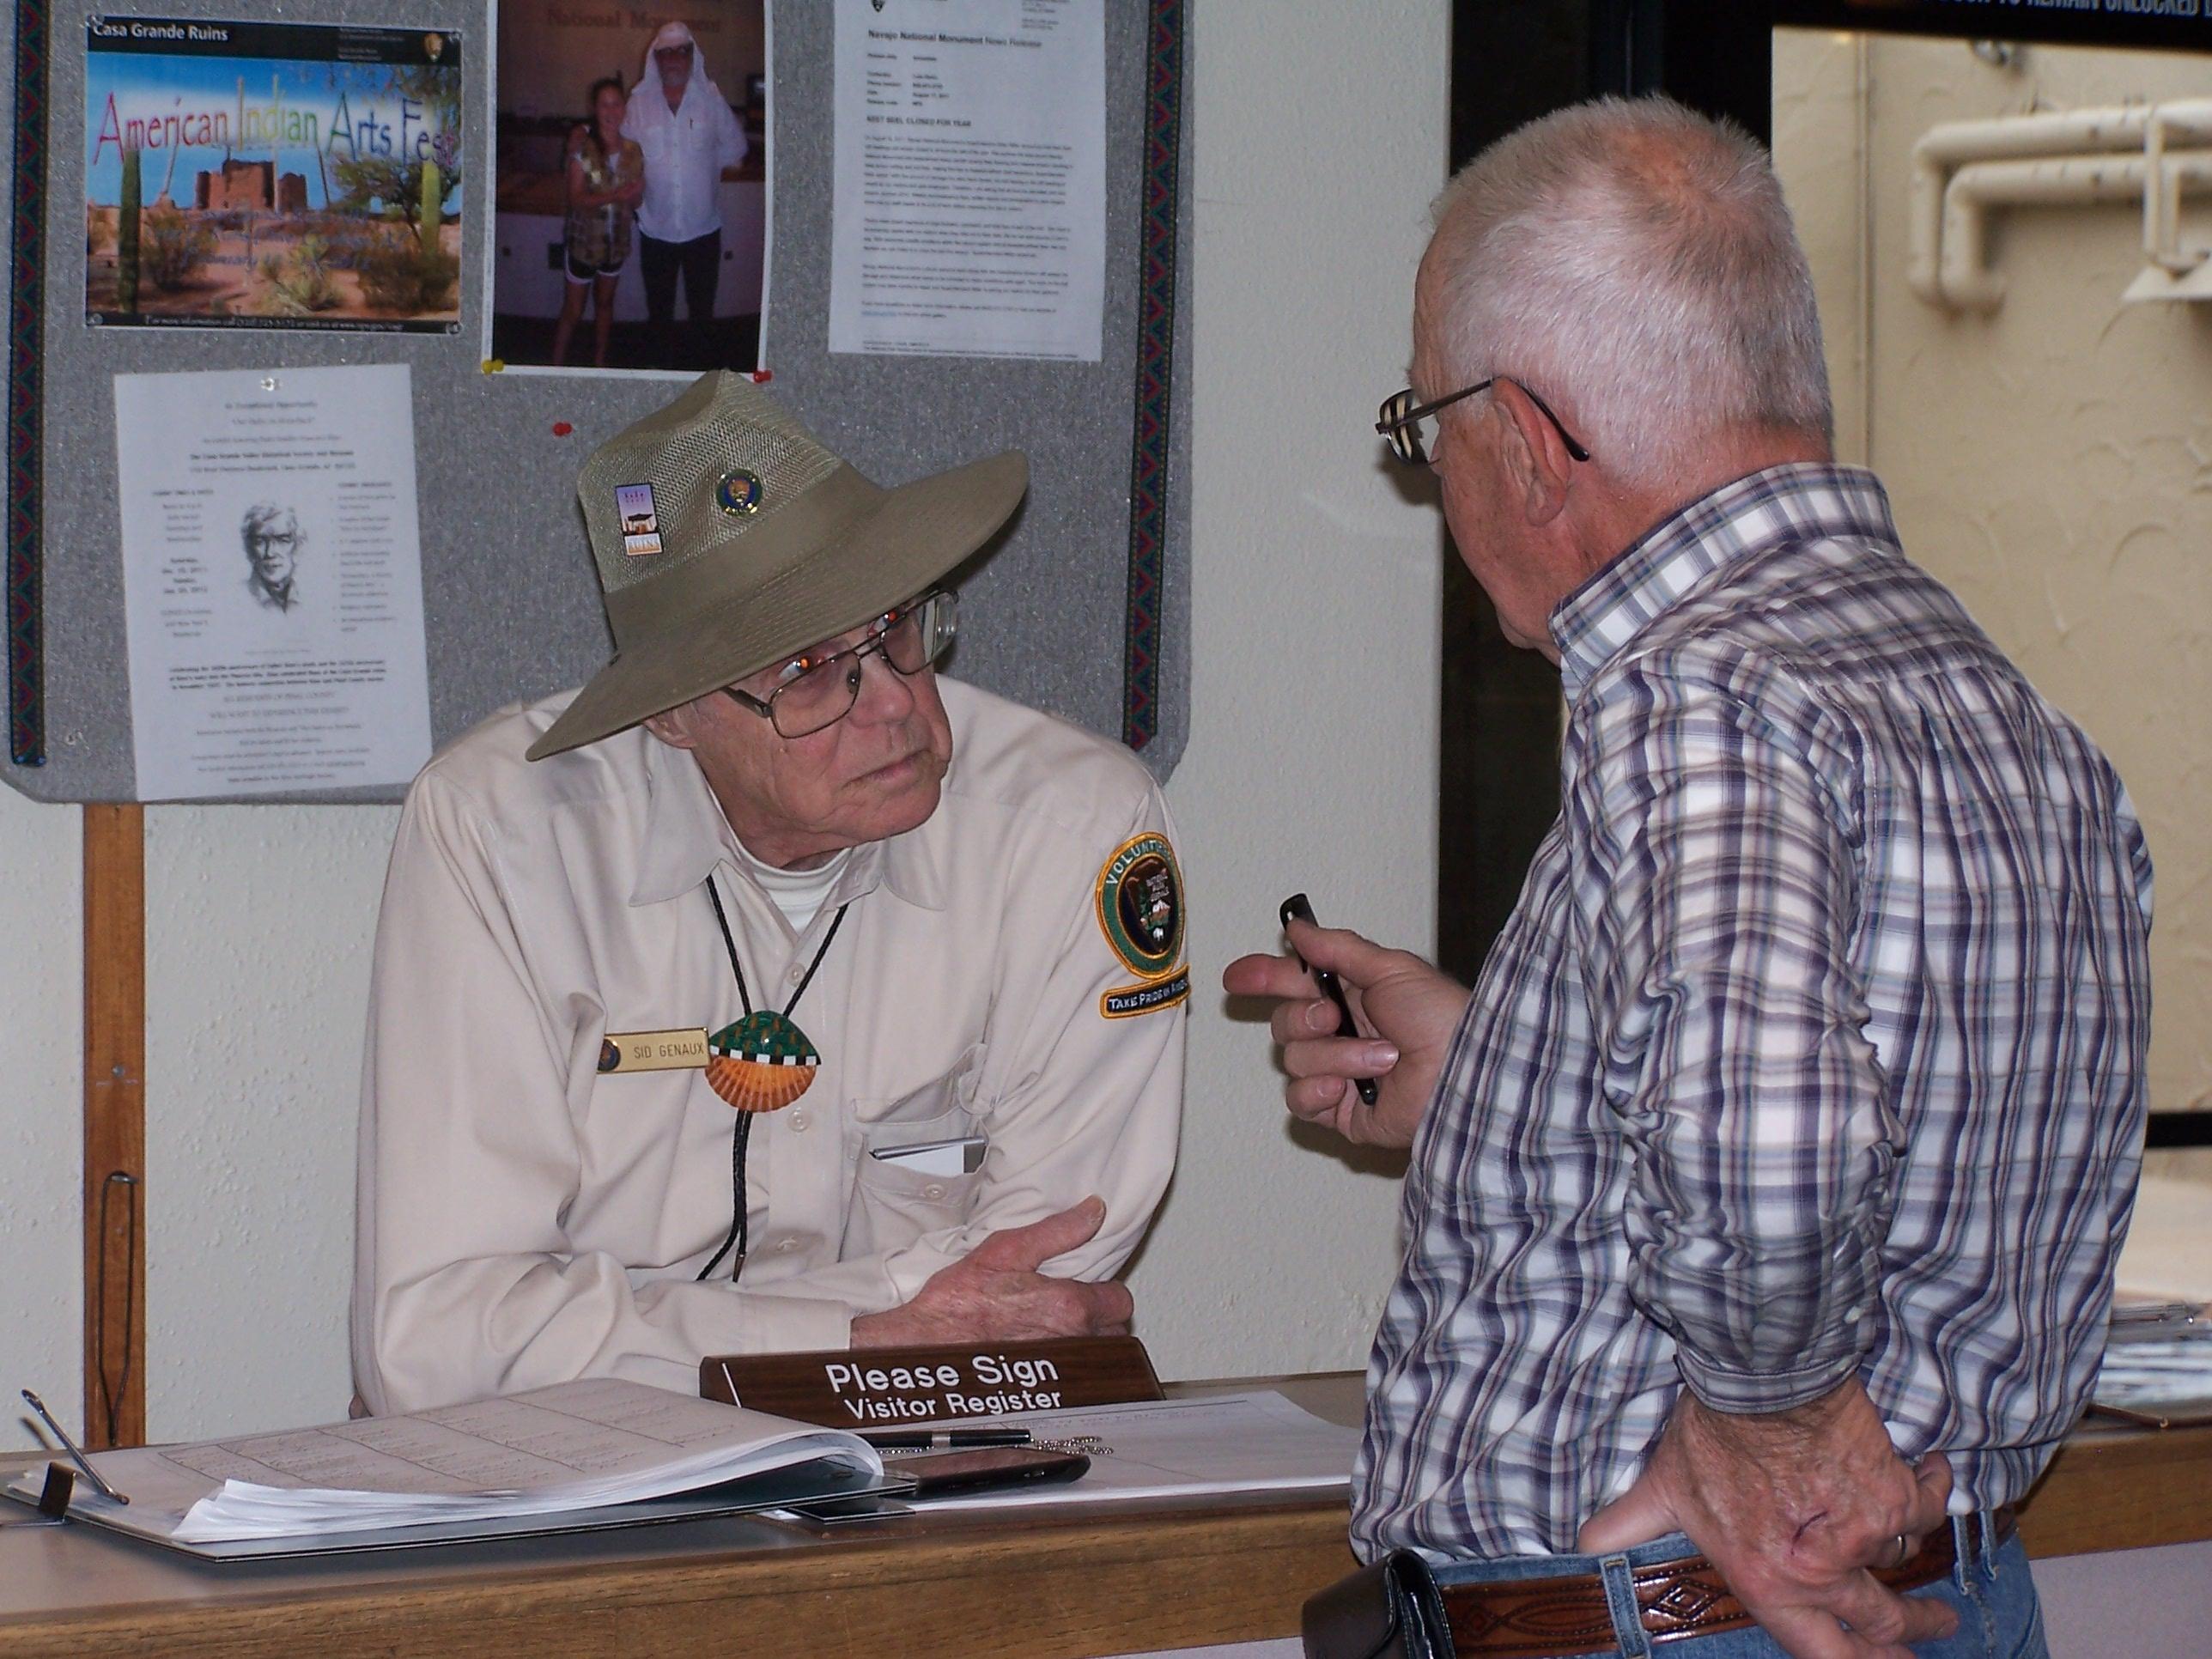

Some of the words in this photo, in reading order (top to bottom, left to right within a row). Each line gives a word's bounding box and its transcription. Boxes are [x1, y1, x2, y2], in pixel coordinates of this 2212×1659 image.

[93, 21, 128, 37] Casa
[131, 22, 185, 40] Grande
[188, 25, 229, 41] Ruins
[92, 92, 229, 167] American
[326, 91, 392, 163] Arts
[1109, 996, 1139, 1010] TAKE
[634, 1045, 653, 1059] SID
[659, 1042, 705, 1057] GENAUX
[825, 1363, 961, 1393] Please
[972, 1355, 1060, 1388] Sign
[844, 1395, 936, 1419] Visitor
[945, 1389, 1062, 1415] Register
